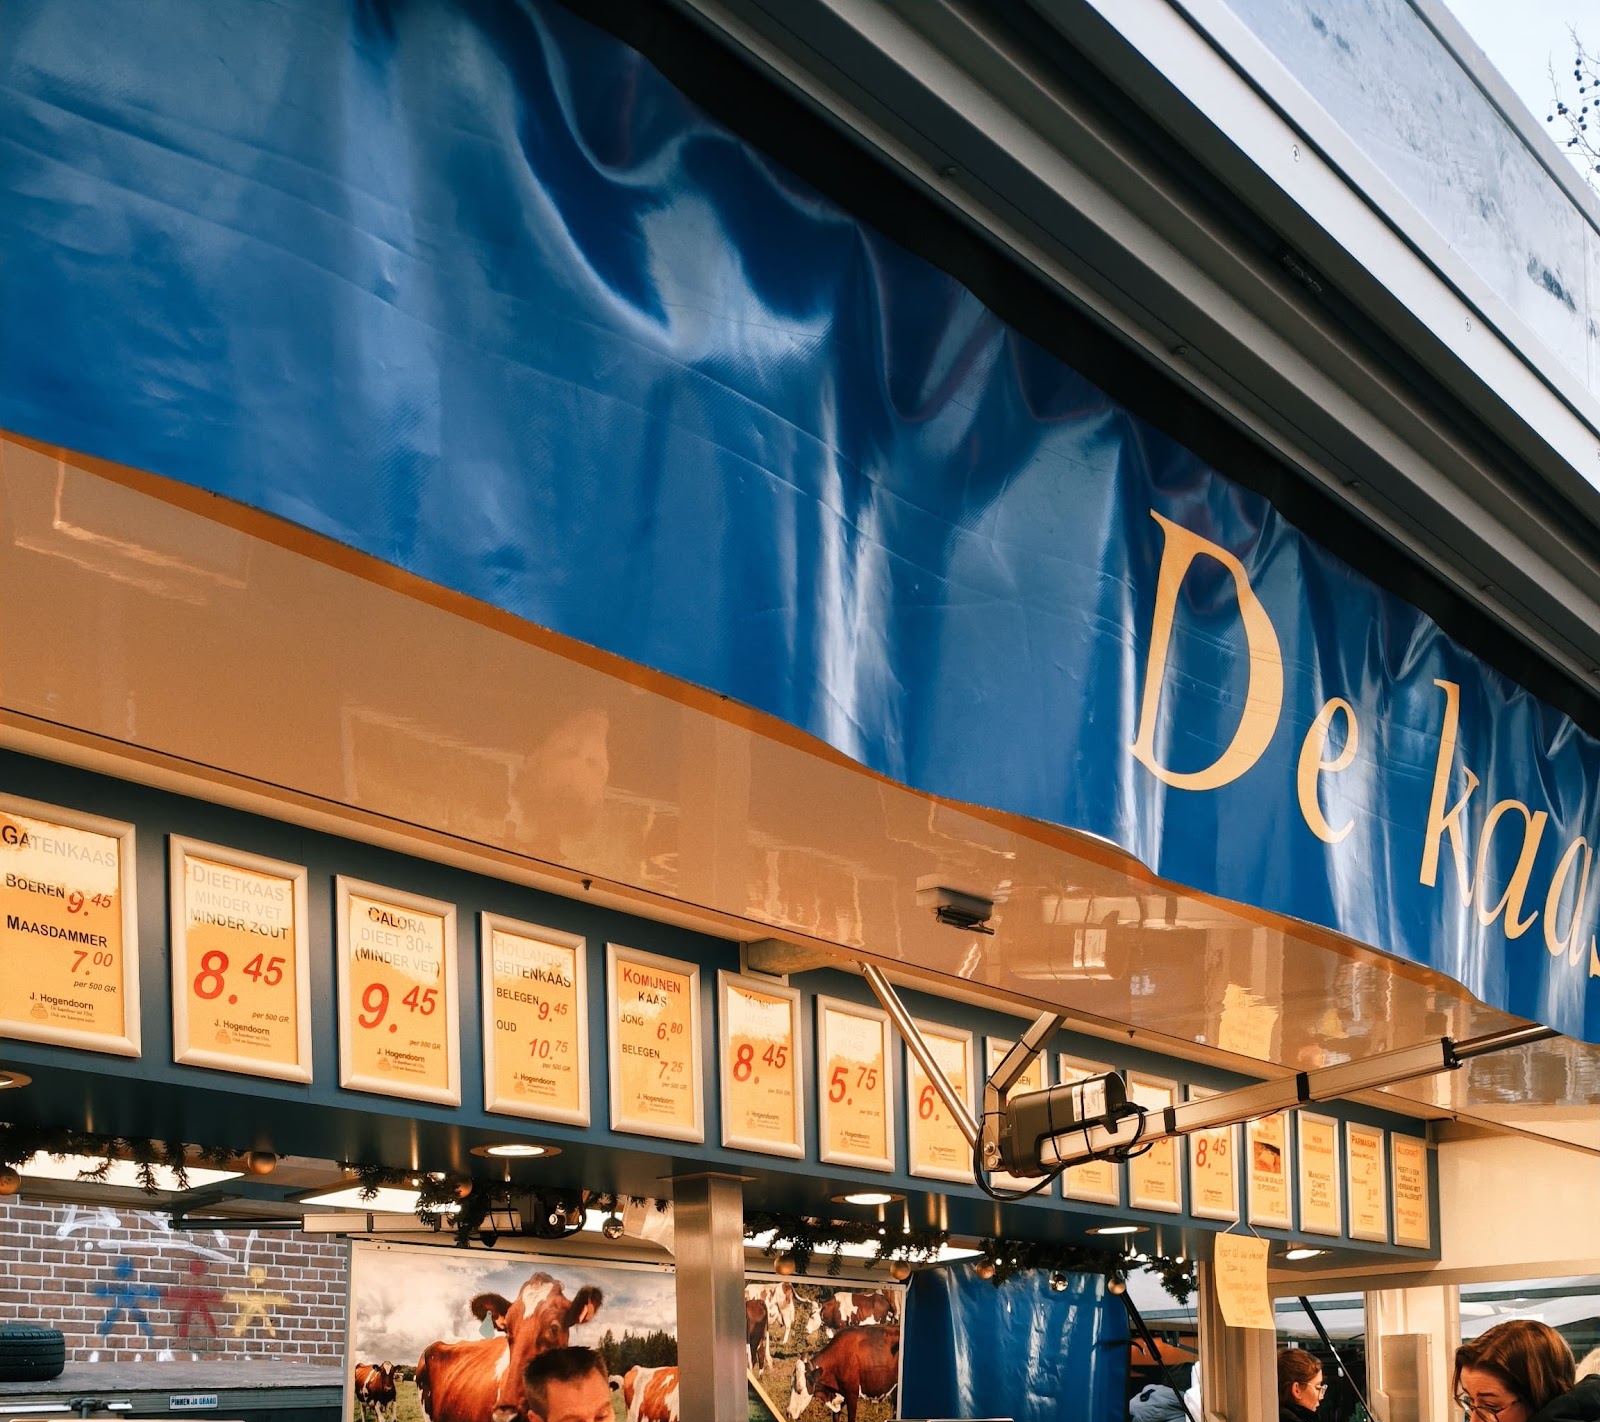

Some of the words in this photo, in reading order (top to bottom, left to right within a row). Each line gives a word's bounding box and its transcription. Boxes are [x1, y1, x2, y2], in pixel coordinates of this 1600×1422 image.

[1129, 509, 1360, 844] De
[2, 825, 116, 867] GATENKAAS
[6, 873, 65, 899] BOEREN
[193, 865, 284, 901] DIEETKAAS
[195, 889, 251, 914] MINDER
[255, 904, 282, 921] VET
[7, 915, 107, 948] MAASDAMMER
[190, 907, 246, 932] MINDER
[250, 921, 288, 940] ZOUT
[368, 907, 426, 935] CALORA
[361, 927, 404, 949] DIEET
[406, 935, 433, 954] 30+
[71, 950, 113, 975] 7.00
[355, 944, 409, 968] (MINDER
[413, 958, 440, 978] VET)
[494, 960, 571, 988] GEITENKAAS
[74, 980, 87, 989] per
[89, 982, 102, 990] 500
[194, 950, 285, 1005] 8.45
[623, 967, 681, 994] KOMIJNEN
[41, 993, 94, 1010] Hogendoorn
[358, 983, 438, 1033] 9.45
[496, 987, 539, 1006] BELEGEN
[638, 991, 667, 1007] KAAS
[224, 1020, 270, 1036] Hogendoorn
[496, 1019, 517, 1032] OUD
[621, 1013, 644, 1026] JONG
[385, 1048, 425, 1062] Hogendoorn
[622, 1044, 660, 1059] BELEGEN
[733, 1044, 788, 1084] 8.45
[829, 1066, 877, 1105] 5.75
[1195, 1138, 1227, 1168] 8.45
